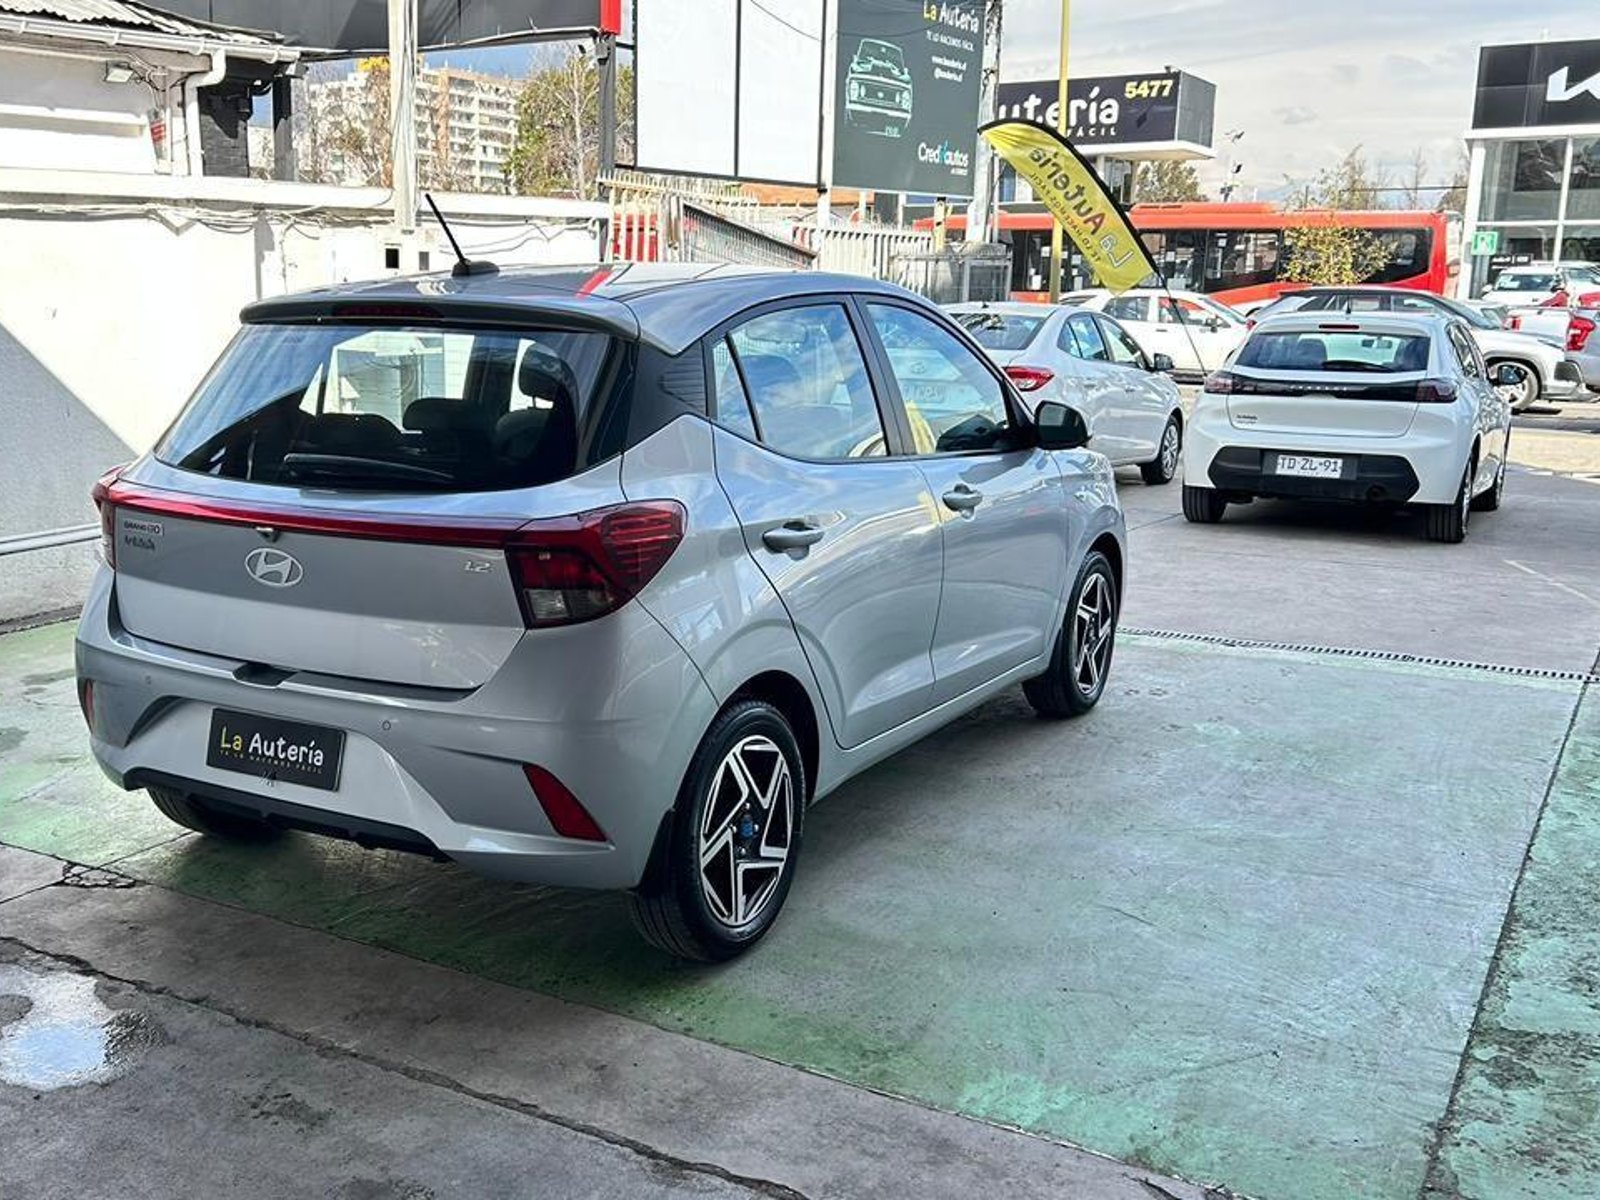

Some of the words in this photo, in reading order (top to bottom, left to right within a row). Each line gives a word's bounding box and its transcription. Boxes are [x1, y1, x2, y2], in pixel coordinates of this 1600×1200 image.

[923, 0, 937, 20] La
[1124, 80, 1173, 98] 5477
[998, 86, 1119, 128] utería
[220, 726, 242, 750] La
[249, 733, 324, 766] Autería
